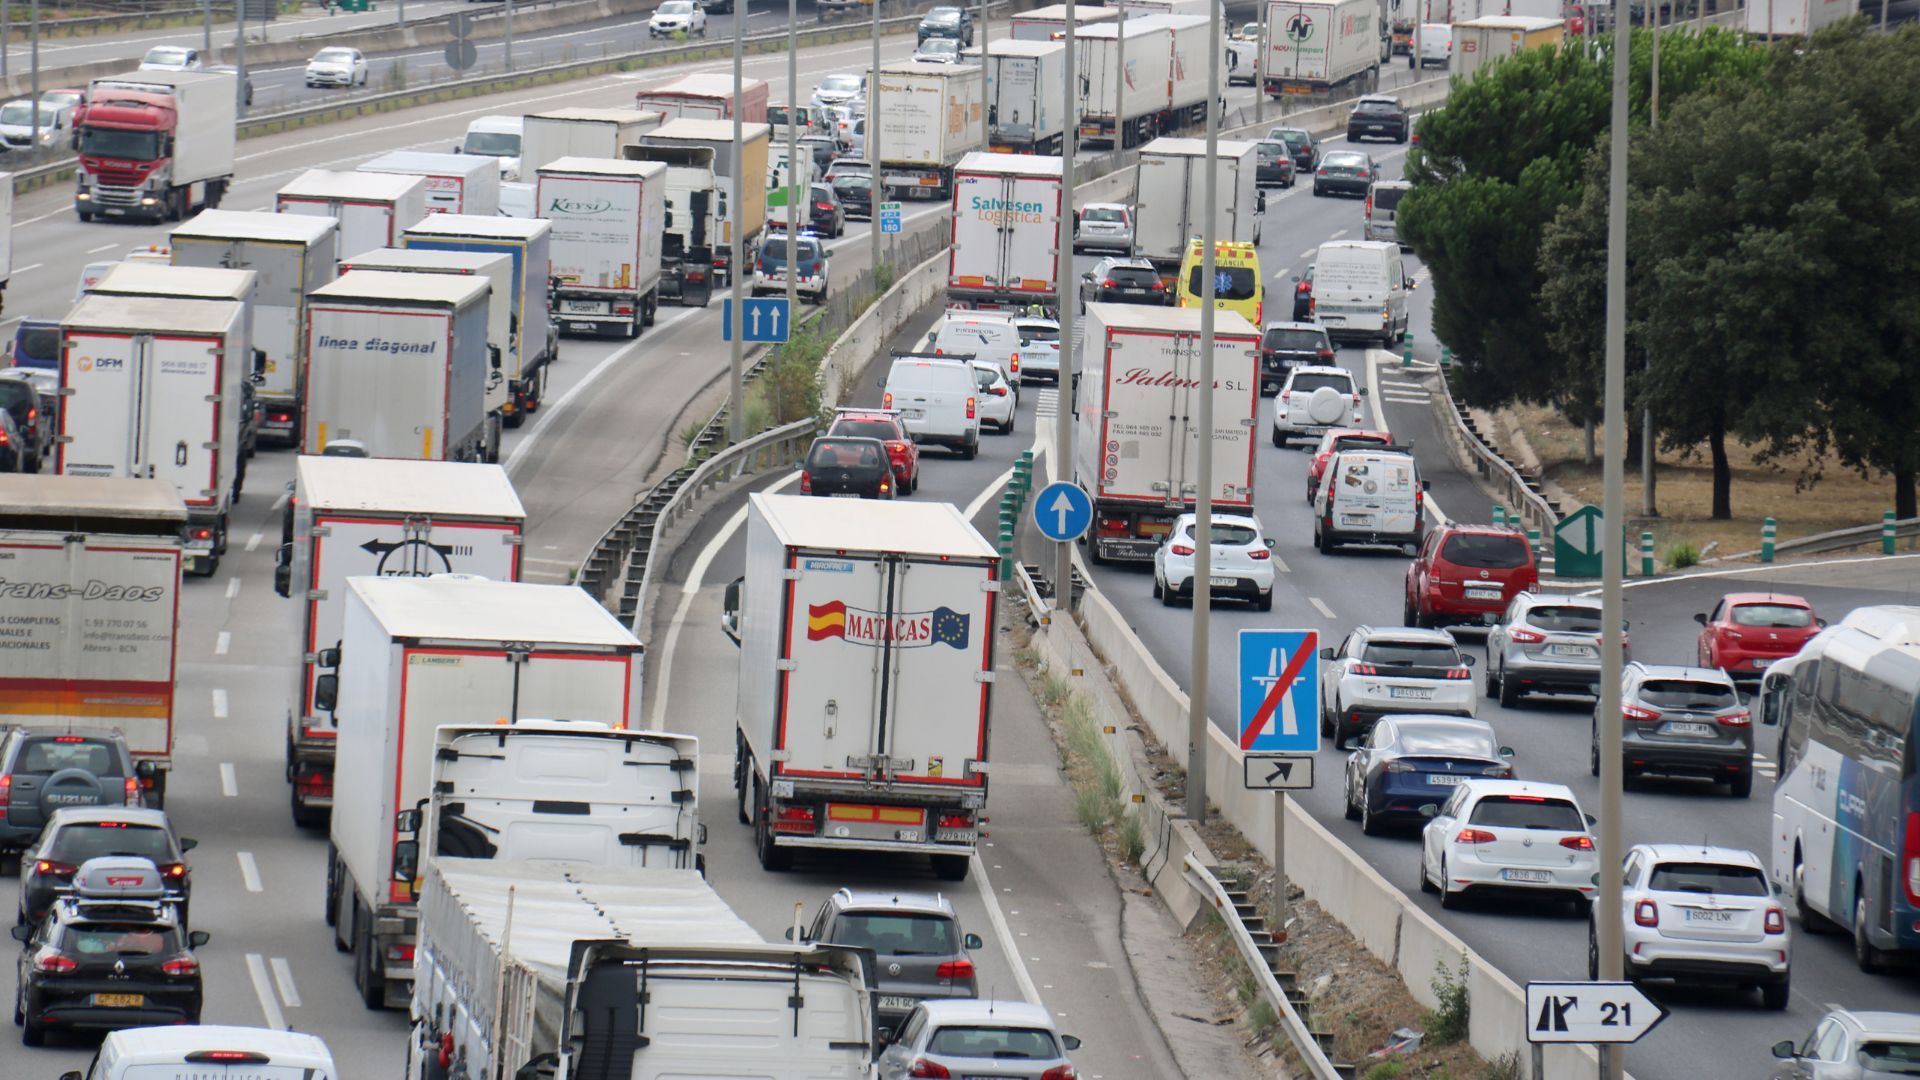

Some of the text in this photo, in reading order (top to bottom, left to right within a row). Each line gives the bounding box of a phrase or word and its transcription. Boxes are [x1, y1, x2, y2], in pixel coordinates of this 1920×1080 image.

[972, 196, 1042, 213] Salvesen
[318, 336, 437, 354] linea diagonal
[96, 358, 123, 368] DFM
[1116, 367, 1248, 391] Salins S.L.
[8, 616, 60, 626] COMPLETAS
[848, 613, 930, 641] MATACAS
[48, 793, 99, 804] SUZUKI
[1601, 1001, 1631, 1026] 21
